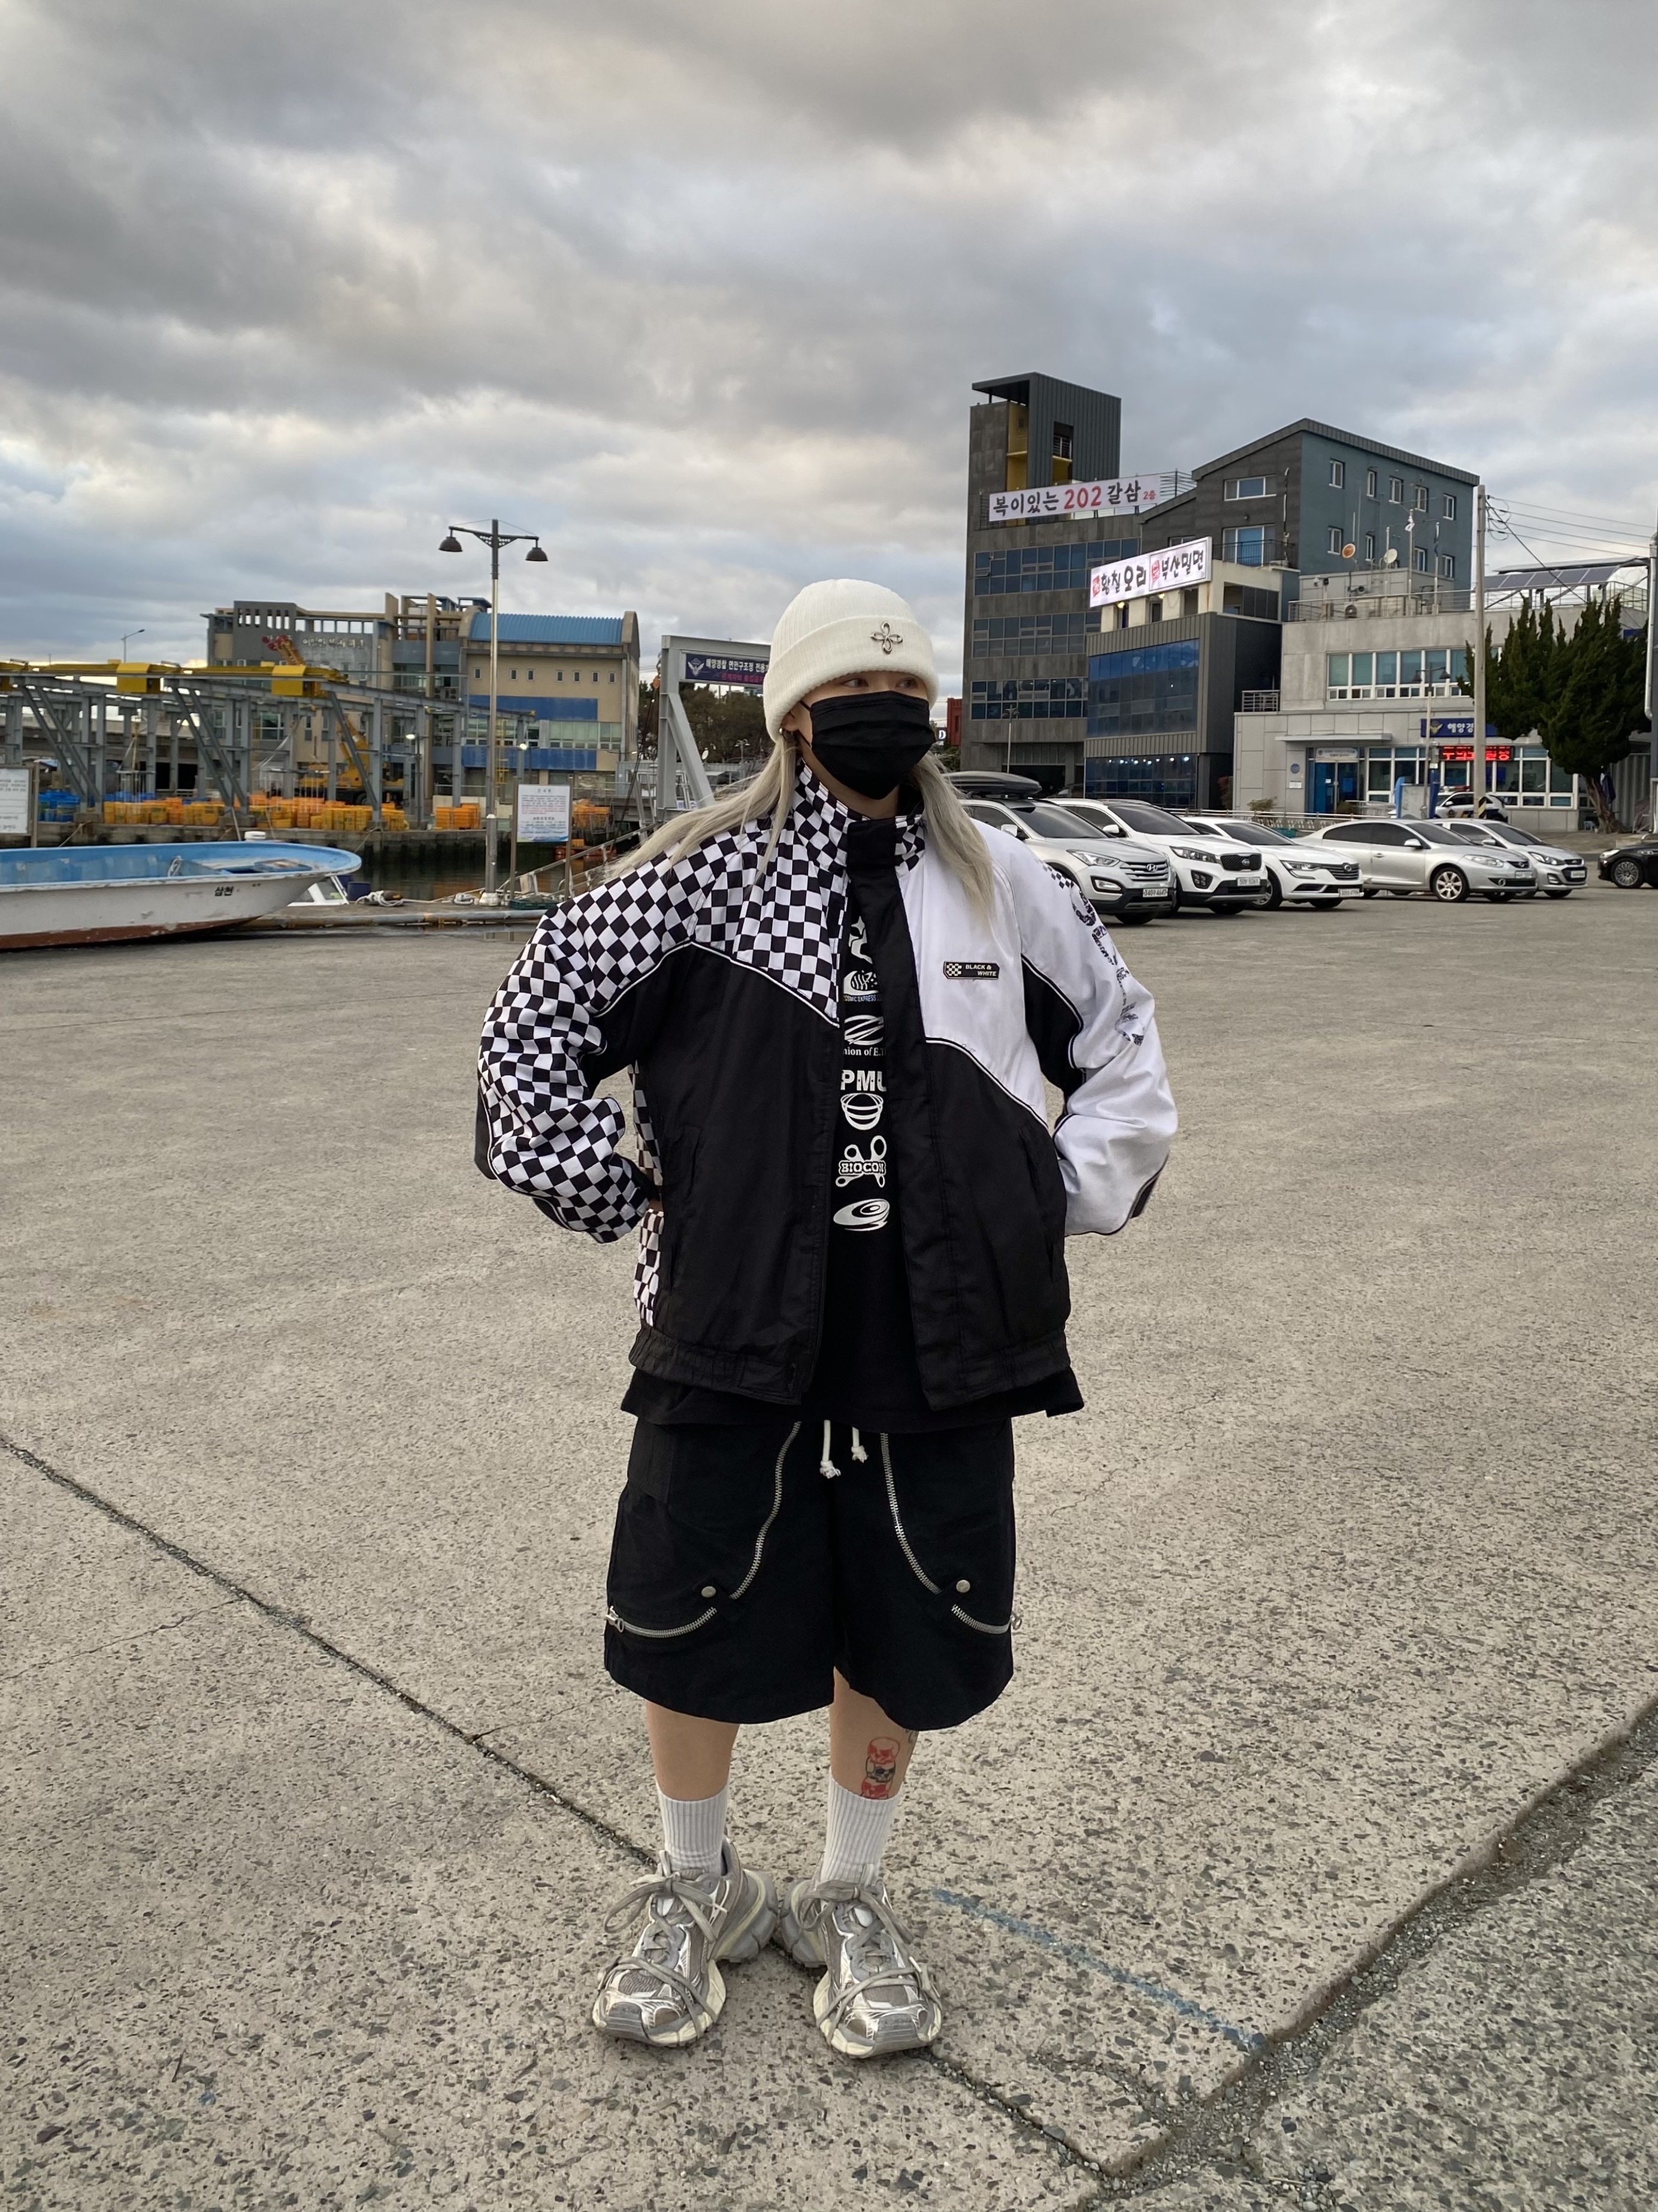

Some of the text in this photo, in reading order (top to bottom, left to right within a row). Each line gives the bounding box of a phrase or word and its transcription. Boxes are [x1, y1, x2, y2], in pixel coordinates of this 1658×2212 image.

[1064, 486, 1102, 510] 202
[1108, 480, 1141, 504] 갈삼
[1143, 489, 1157, 500] 2층
[1161, 549, 1204, 581] 부산밀면
[706, 658, 727, 669] 해양경찰
[864, 1047, 873, 1056] of
